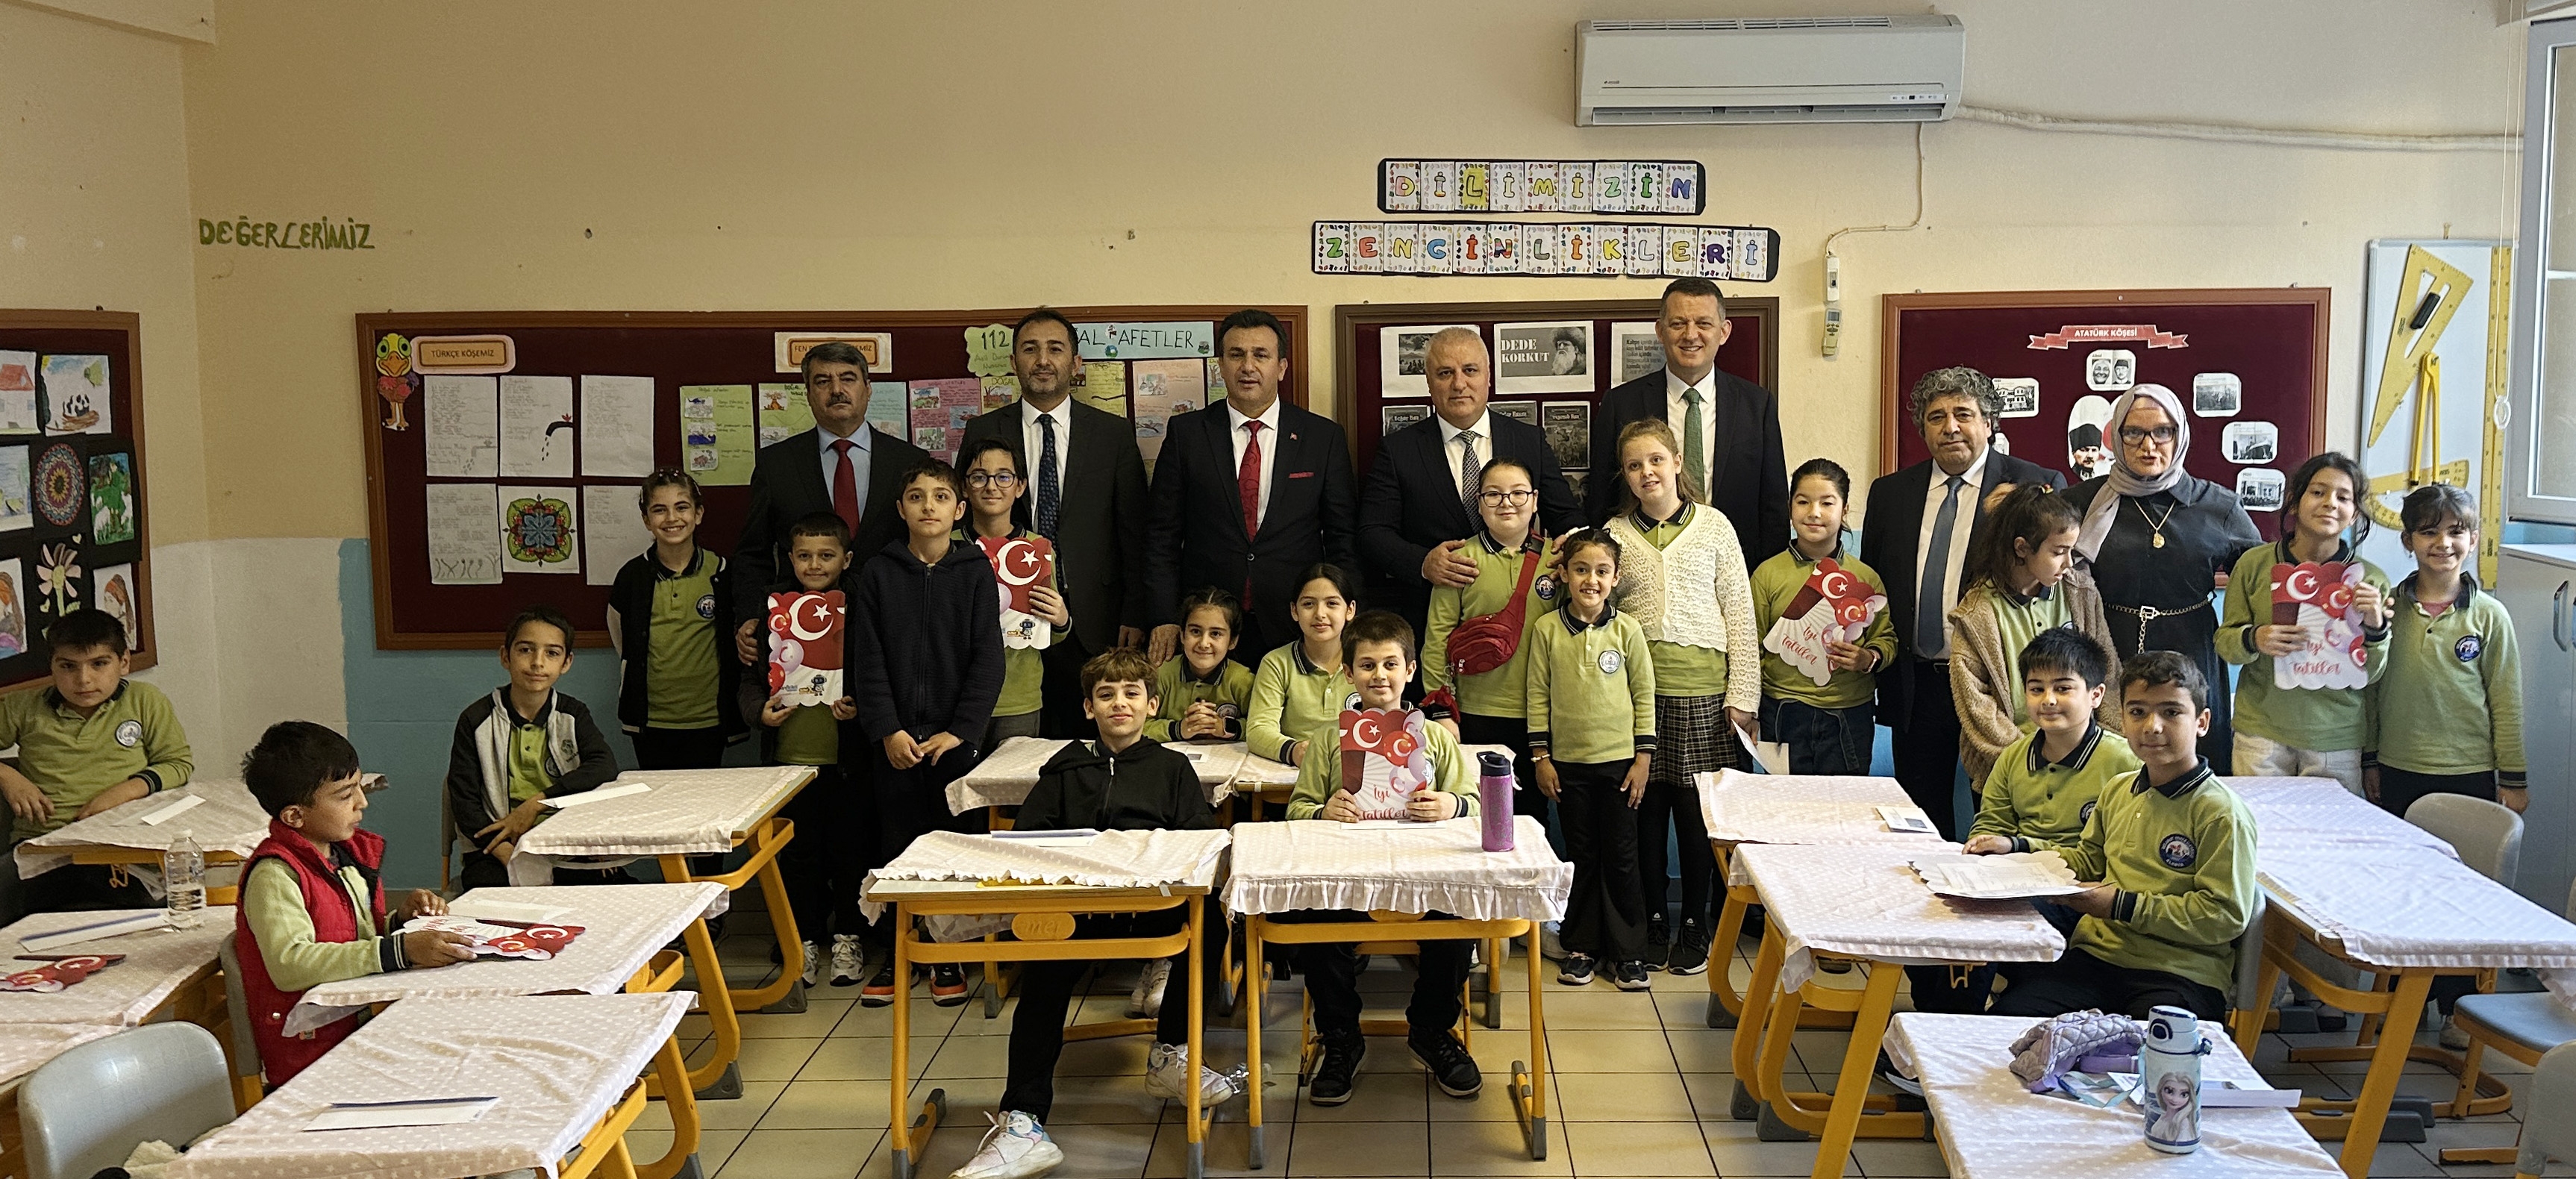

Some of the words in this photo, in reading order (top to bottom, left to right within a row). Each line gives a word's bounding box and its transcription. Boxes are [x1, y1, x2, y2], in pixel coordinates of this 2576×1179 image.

[1395, 171, 1692, 200] DİLİMİZİN
[198, 215, 375, 250] DEĞERLERİMİZ
[1325, 233, 1758, 266] ZENGİNLİKLERİ
[981, 329, 1010, 350] 112
[1119, 329, 1194, 348] AFETLER
[2075, 328, 2110, 337] ATATÜRK
[2110, 326, 2138, 338] KÖŞESİ
[431, 349, 460, 358] TÜRKÇE
[461, 348, 495, 358] KÖŞEMİZ
[1501, 339, 1537, 351] DEDE
[1501, 352, 1550, 363] KORKUT
[1373, 784, 1391, 804] İyi
